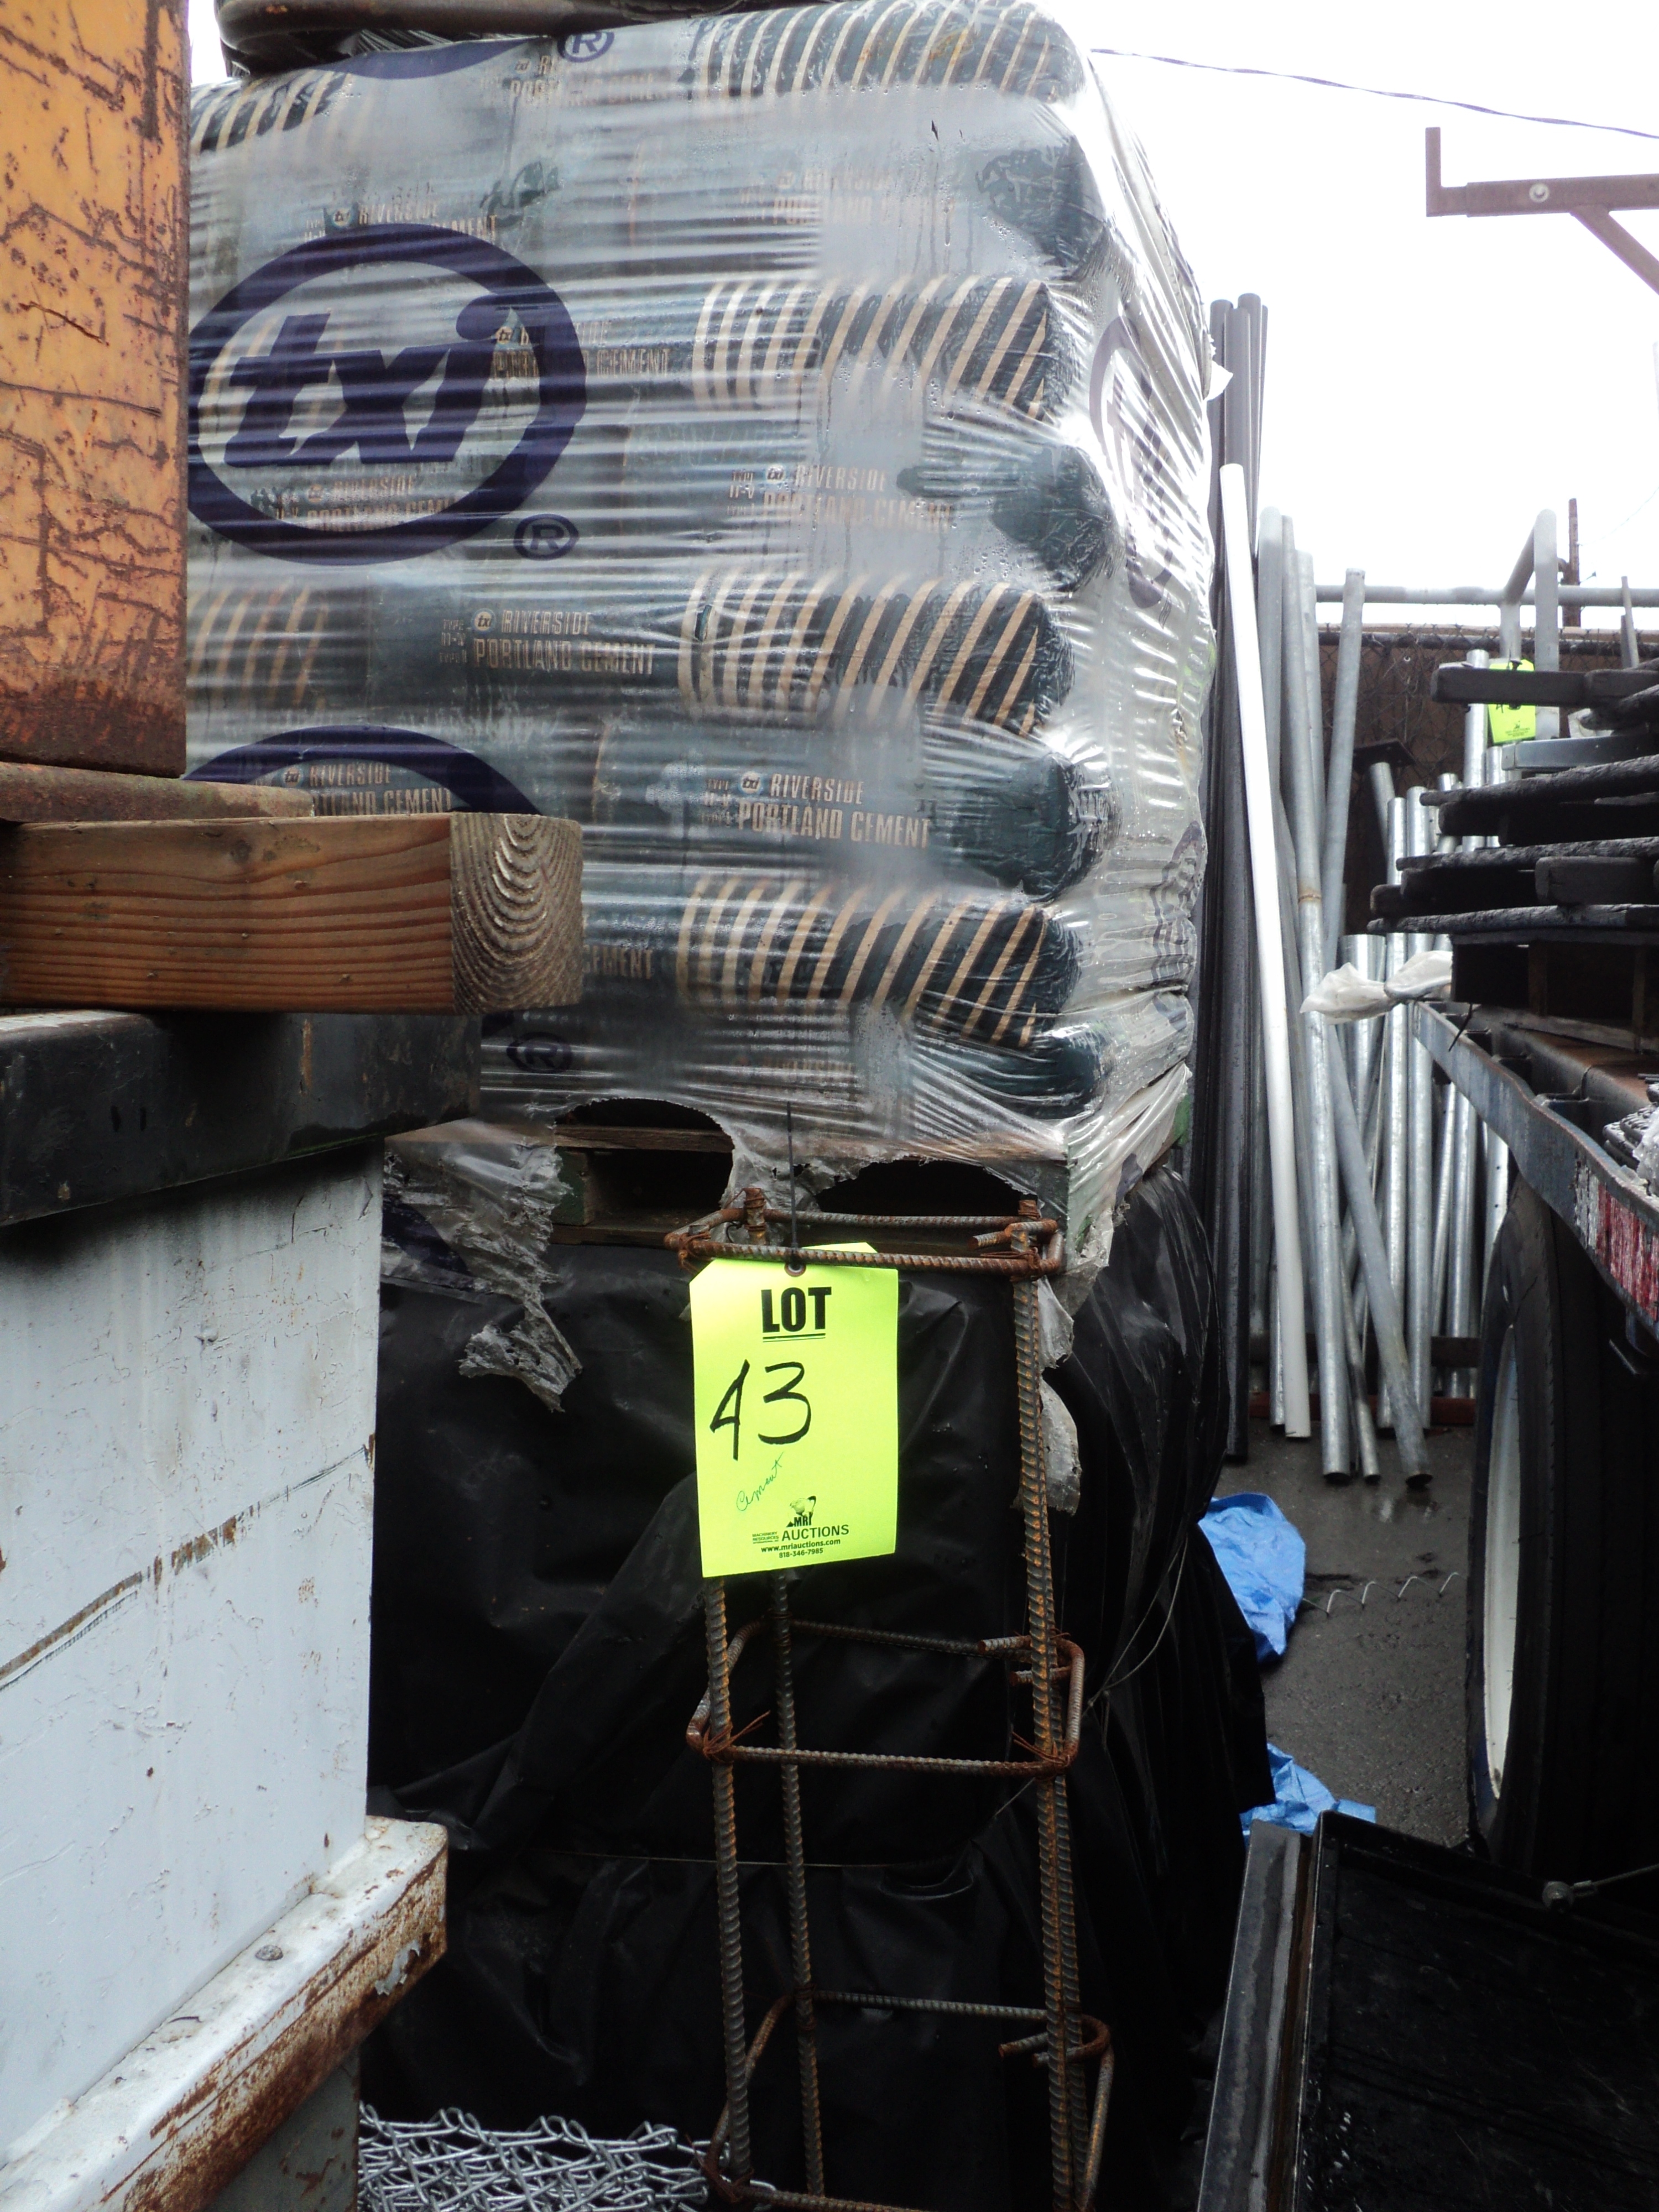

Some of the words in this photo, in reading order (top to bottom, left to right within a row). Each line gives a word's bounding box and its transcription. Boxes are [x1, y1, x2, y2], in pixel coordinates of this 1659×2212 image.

[794, 464, 885, 492] RIVERSIDE
[502, 609, 593, 635] RIVERSIDE
[474, 638, 572, 671] PORTLAND
[580, 641, 656, 675] CEMENT
[310, 763, 390, 786] RIVERSIDE
[770, 773, 864, 805] RIVERSIDE
[738, 800, 843, 840] PORTLAND
[850, 810, 931, 849] CEMENT
[760, 1286, 832, 1333] LOT
[709, 1359, 812, 1462] 43
[794, 1511, 813, 1527] MRI
[761, 1539, 841, 1553] www.mriauctions.com
[781, 1524, 850, 1542] AUCTIONS
[779, 1547, 824, 1558] 818-346-7985
